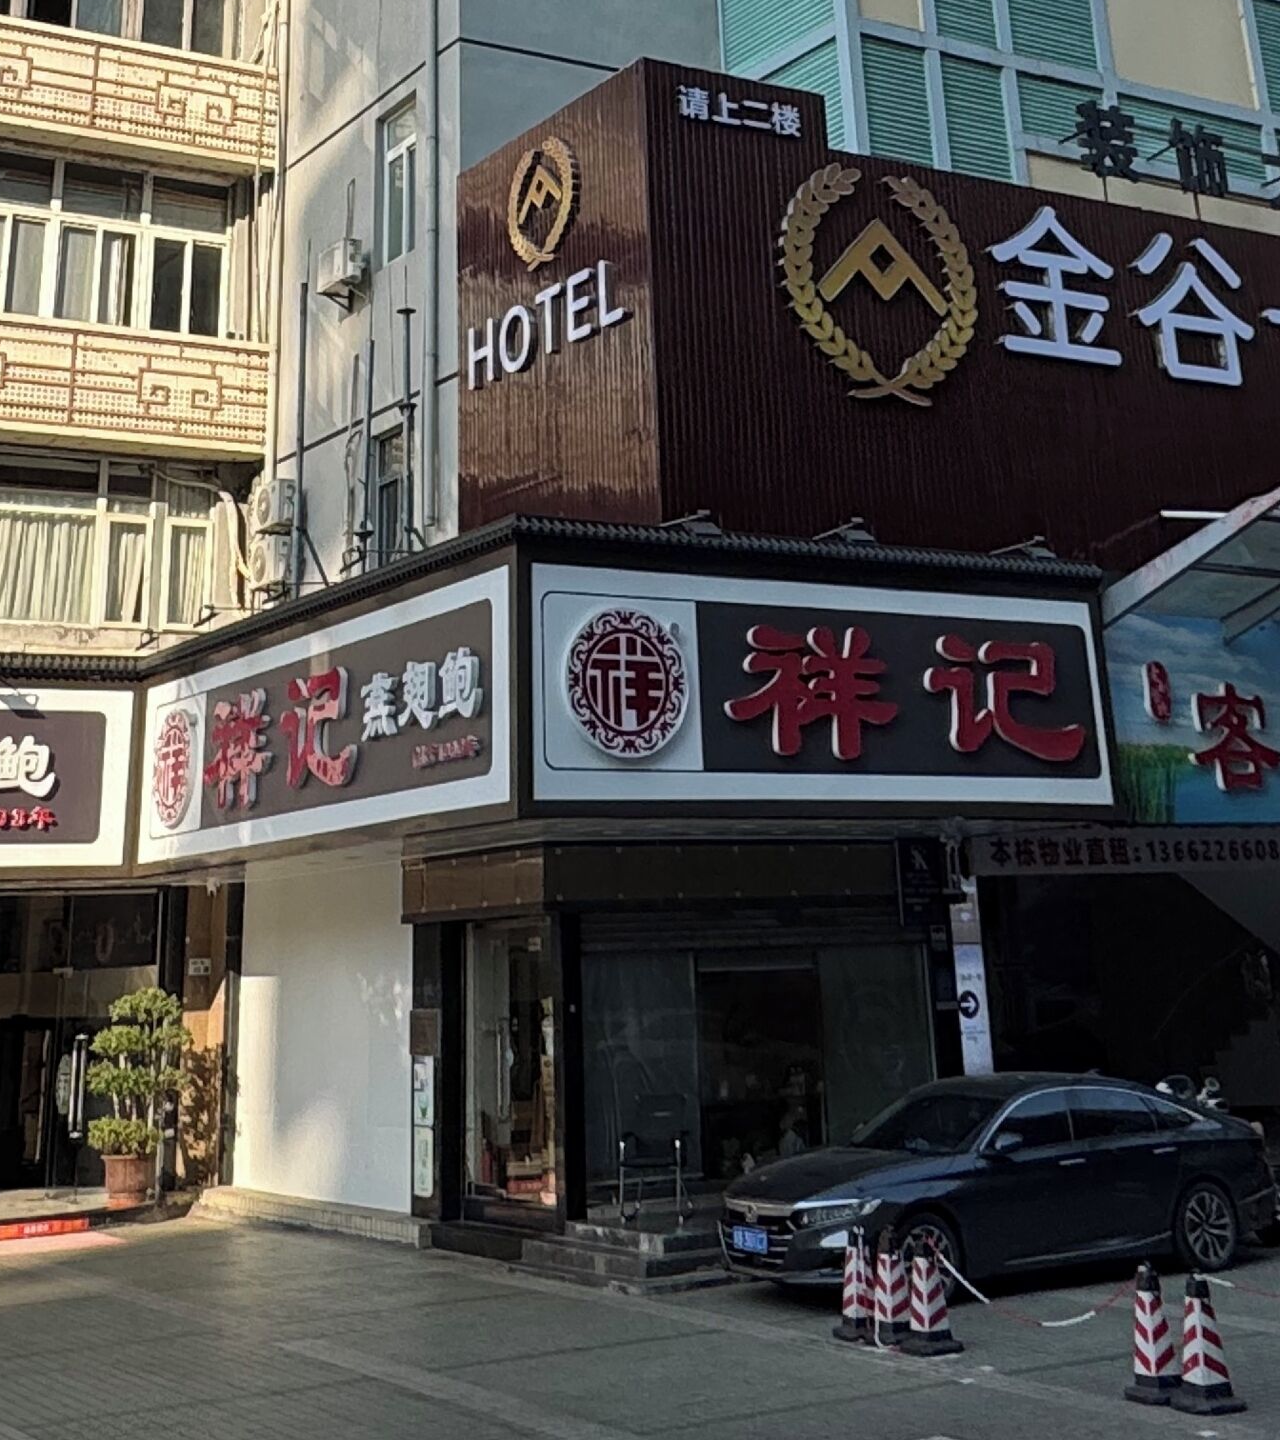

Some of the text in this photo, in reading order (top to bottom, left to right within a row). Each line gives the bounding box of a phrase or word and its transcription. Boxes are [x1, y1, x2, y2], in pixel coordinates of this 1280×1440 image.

[677, 85, 801, 138] 请上二楼
[467, 259, 626, 391] HOTEL
[204, 665, 360, 810] 祥记
[361, 647, 484, 742] 燕翅鲍
[725, 624, 1086, 763] 祥记
